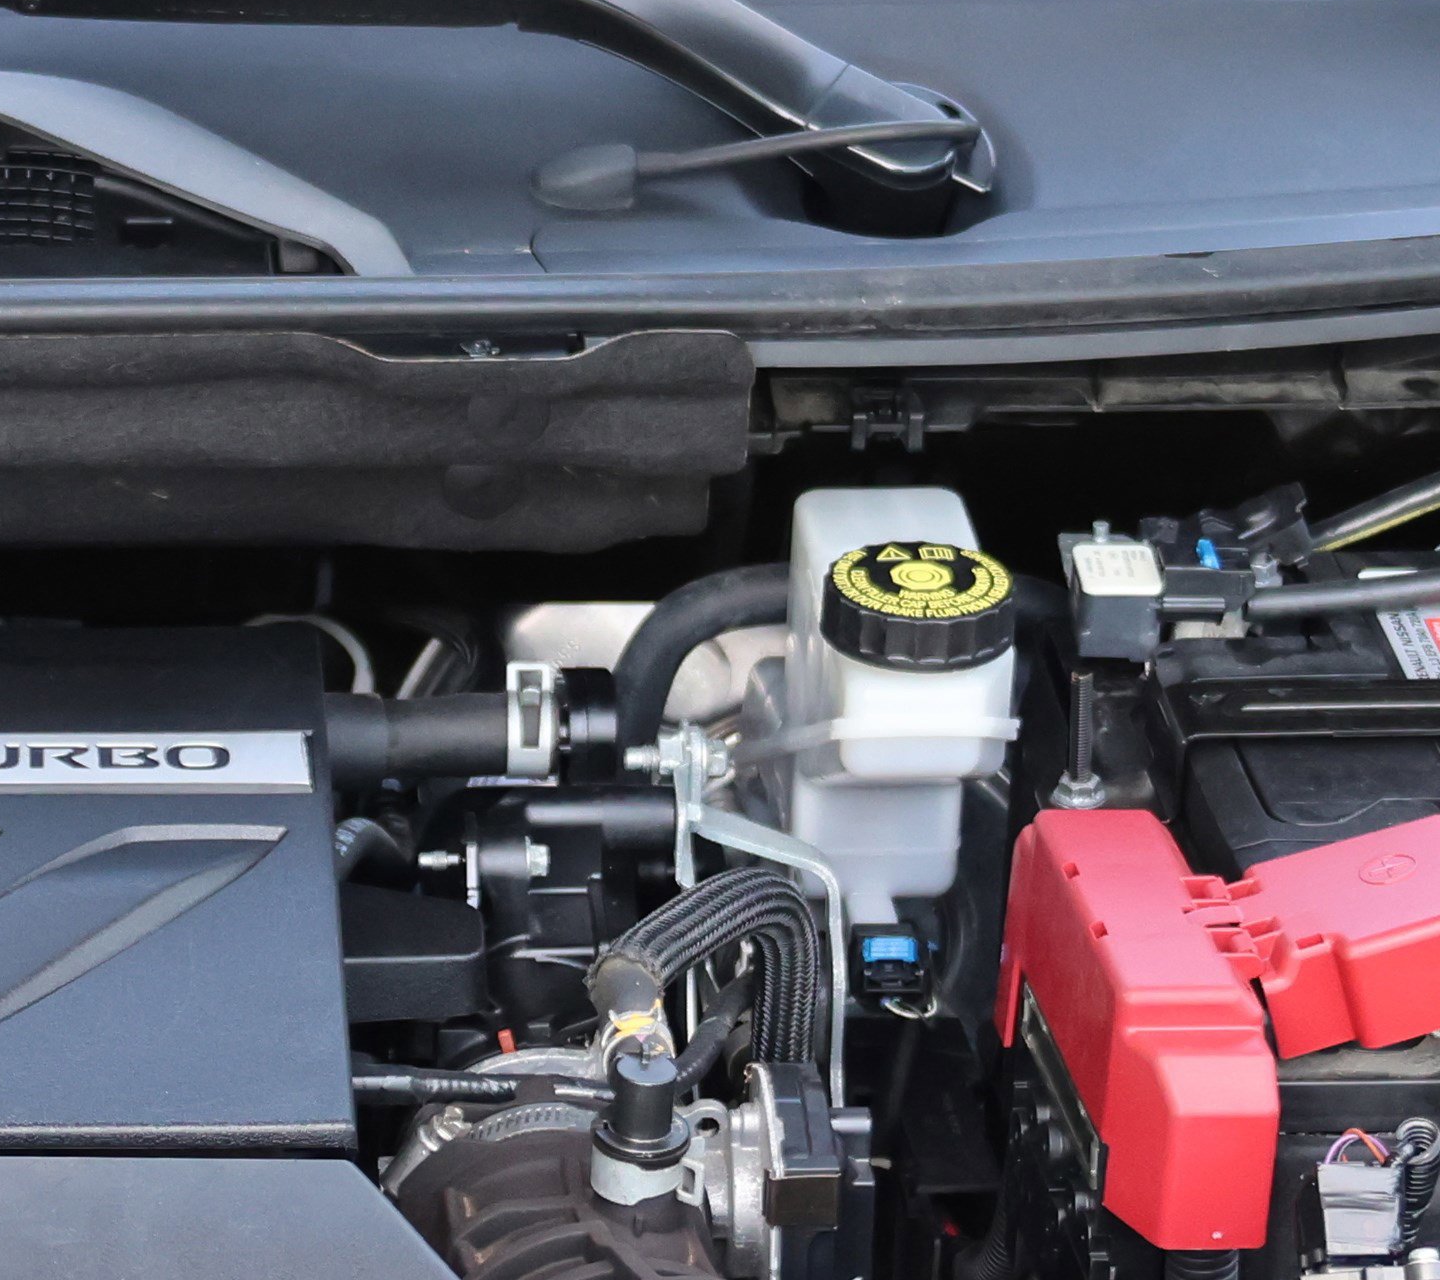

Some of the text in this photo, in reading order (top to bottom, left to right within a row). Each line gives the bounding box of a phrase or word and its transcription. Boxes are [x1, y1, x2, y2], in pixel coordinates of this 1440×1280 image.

[899, 588, 956, 601] WARNING
[900, 597, 926, 609] CAP
[927, 593, 970, 609] BEFORE
[880, 604, 924, 619] BRAKE
[925, 605, 962, 619] FLUID
